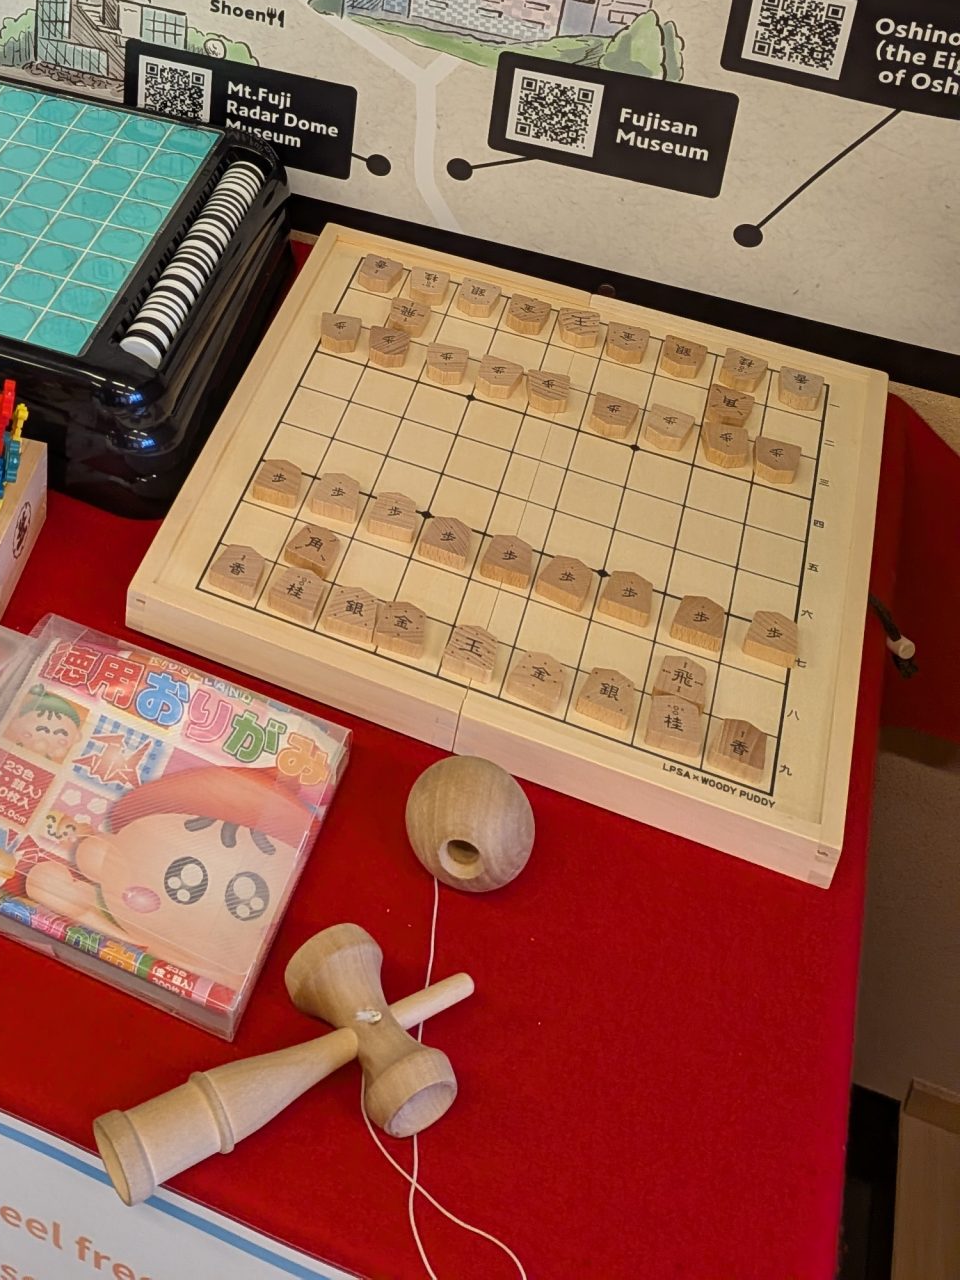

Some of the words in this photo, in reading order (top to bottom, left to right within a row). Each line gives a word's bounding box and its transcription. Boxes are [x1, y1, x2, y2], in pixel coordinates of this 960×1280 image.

[210, 0, 266, 23] Shoen
[619, 107, 698, 138] Fujisan
[615, 127, 709, 161] Museum
[305, 535, 325, 552] 角
[229, 563, 246, 577] 香
[286, 583, 304, 600] 桂
[345, 600, 365, 617] 銀
[693, 611, 710, 624] 歩
[393, 614, 412, 630] 金
[463, 639, 483, 657] 玉
[671, 668, 694, 688] 飛
[38, 642, 331, 786] 徳用おりがみ
[3, 759, 35, 781] 23色
[662, 763, 691, 781] LPSA
[700, 776, 738, 795] WOODY
[739, 789, 776, 808] PUDDY
[74, 1235, 153, 1280] fre
